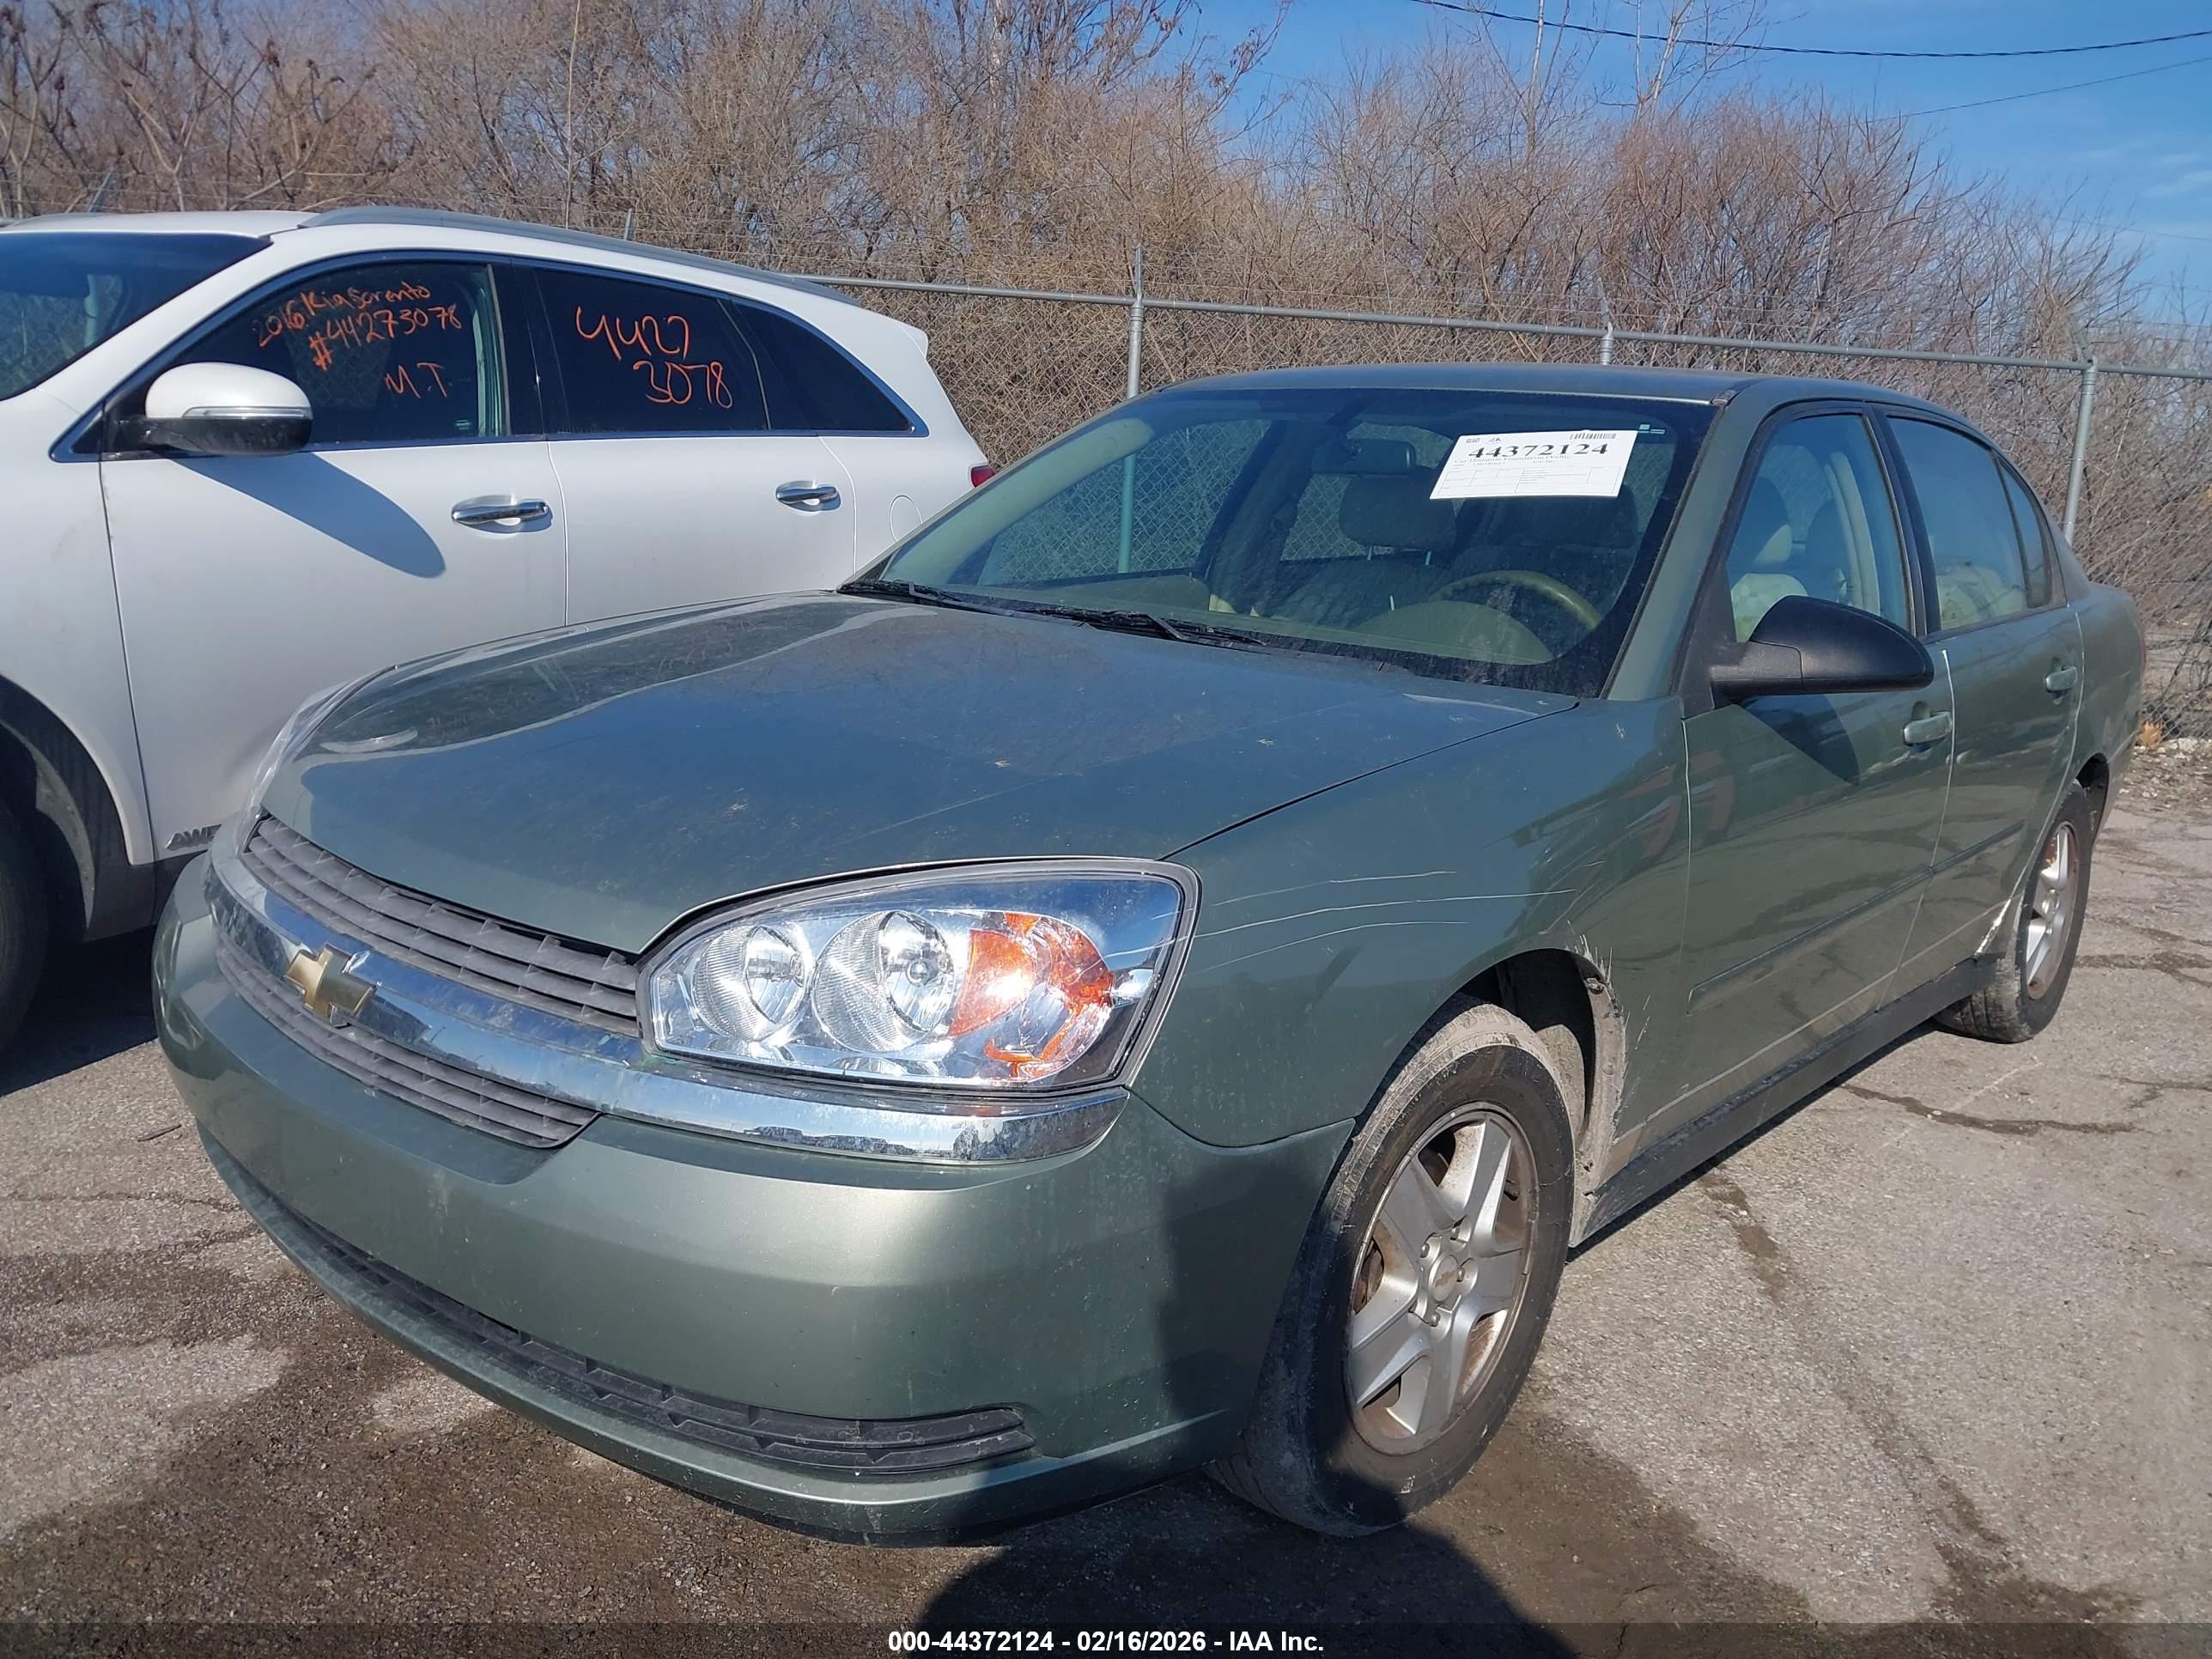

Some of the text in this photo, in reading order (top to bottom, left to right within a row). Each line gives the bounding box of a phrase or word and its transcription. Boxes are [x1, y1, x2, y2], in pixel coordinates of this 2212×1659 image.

[308, 303, 463, 372] #44273078
[575, 305, 690, 362] 4427
[632, 361, 733, 410] 3078
[1468, 443, 1608, 459] 44372124
